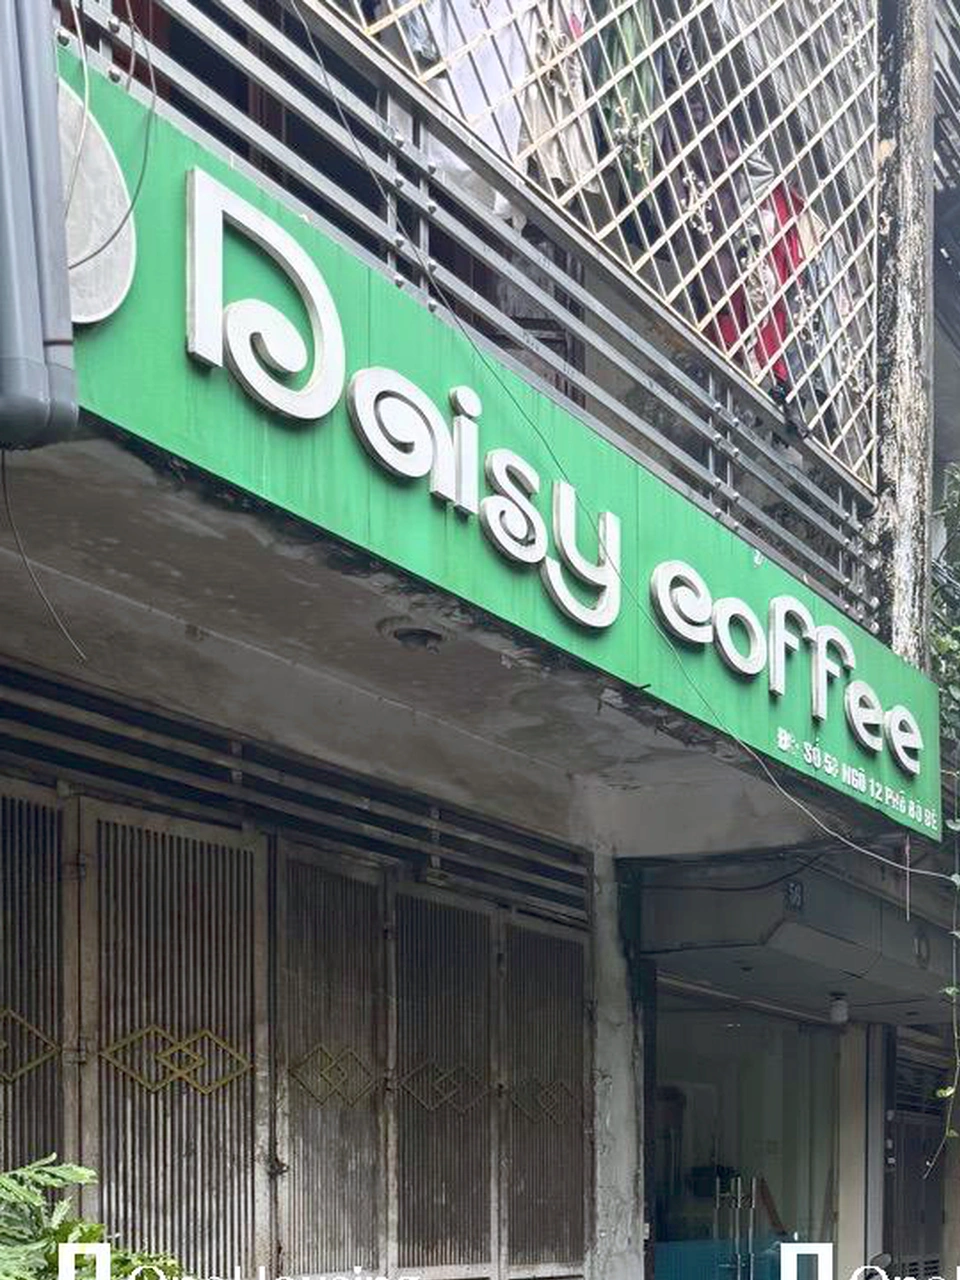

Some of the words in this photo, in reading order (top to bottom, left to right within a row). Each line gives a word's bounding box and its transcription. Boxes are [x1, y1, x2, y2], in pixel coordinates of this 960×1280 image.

[187, 165, 622, 629] Daisy
[650, 560, 924, 775] coffee
[869, 778, 883, 802] 12
